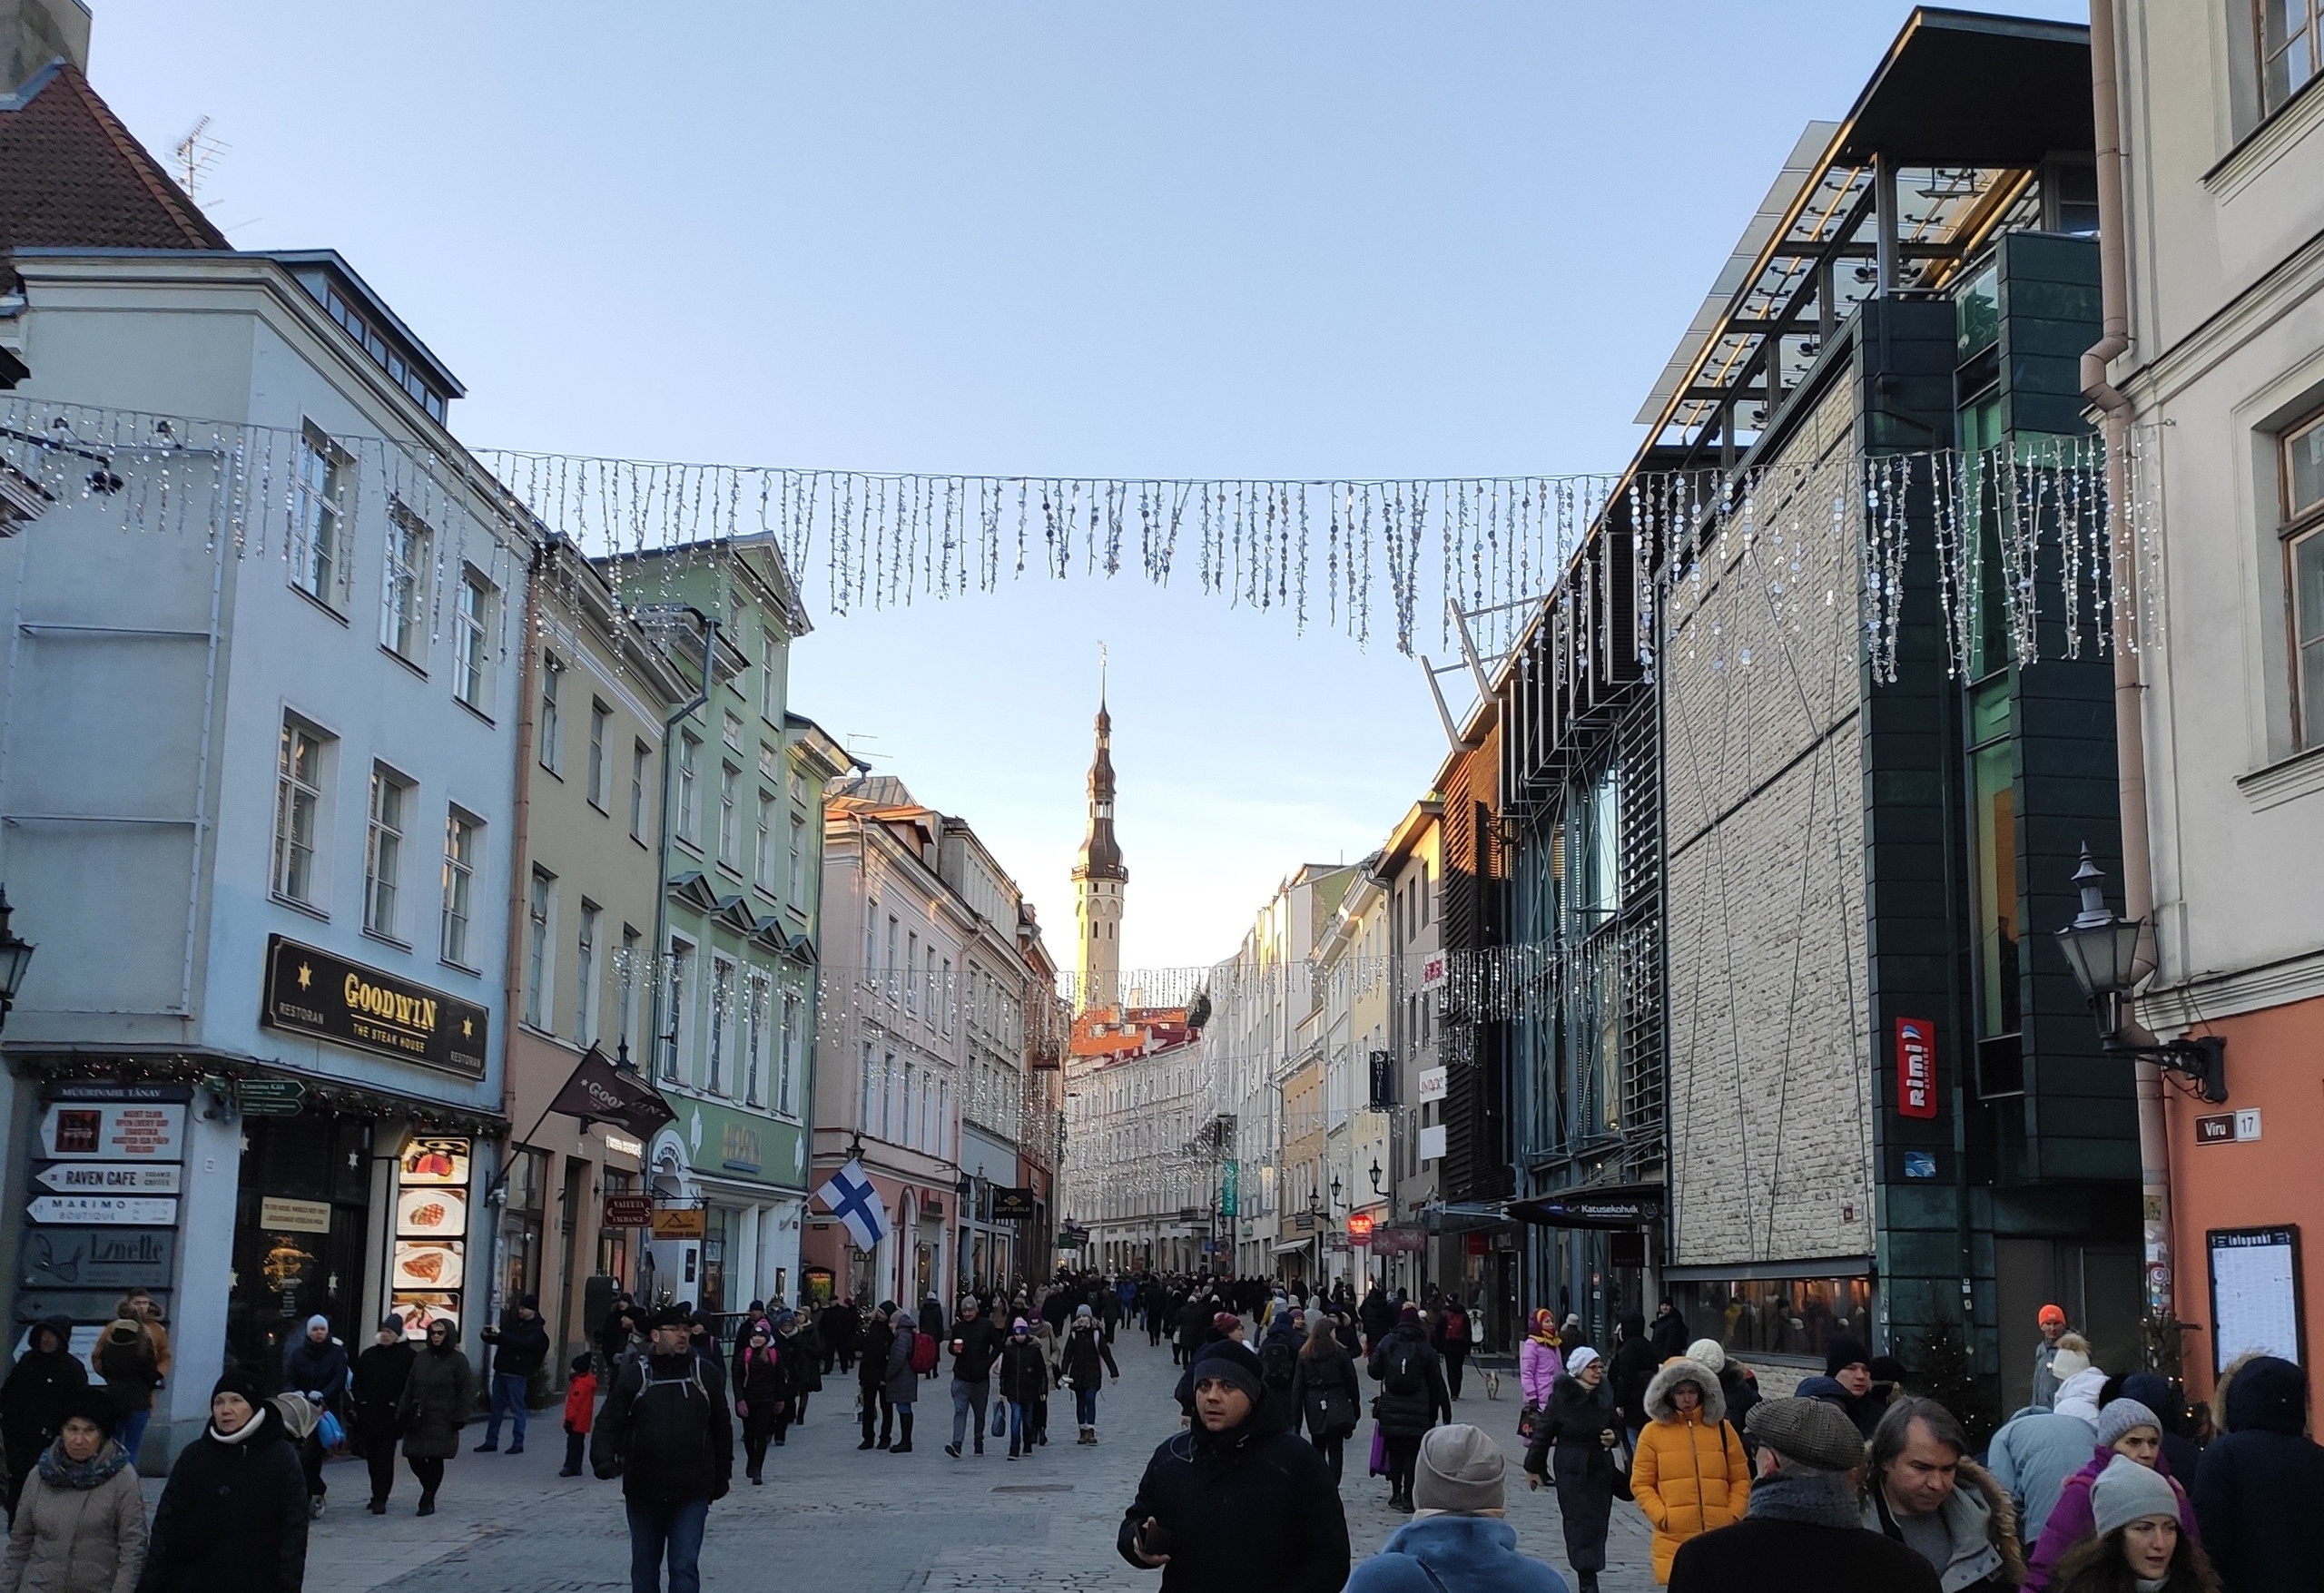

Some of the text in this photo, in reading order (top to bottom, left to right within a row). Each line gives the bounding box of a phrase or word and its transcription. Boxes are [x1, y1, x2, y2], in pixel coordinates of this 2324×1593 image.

[344, 972, 438, 1032] GOODWIN
[279, 1002, 324, 1026] RESTORAN
[353, 1023, 426, 1054] THE STEAK HOUSE
[450, 1050, 481, 1067] RESTORAN
[2204, 1116, 2253, 1136] Viru 17
[65, 1171, 103, 1185] RAVEN
[106, 1171, 137, 1186] CAFE
[52, 1199, 125, 1209] MARIMO
[1581, 1204, 1639, 1214] Katusekohvik
[59, 1212, 115, 1221] BOUTIQUE
[613, 1215, 644, 1224] EXCHANGE
